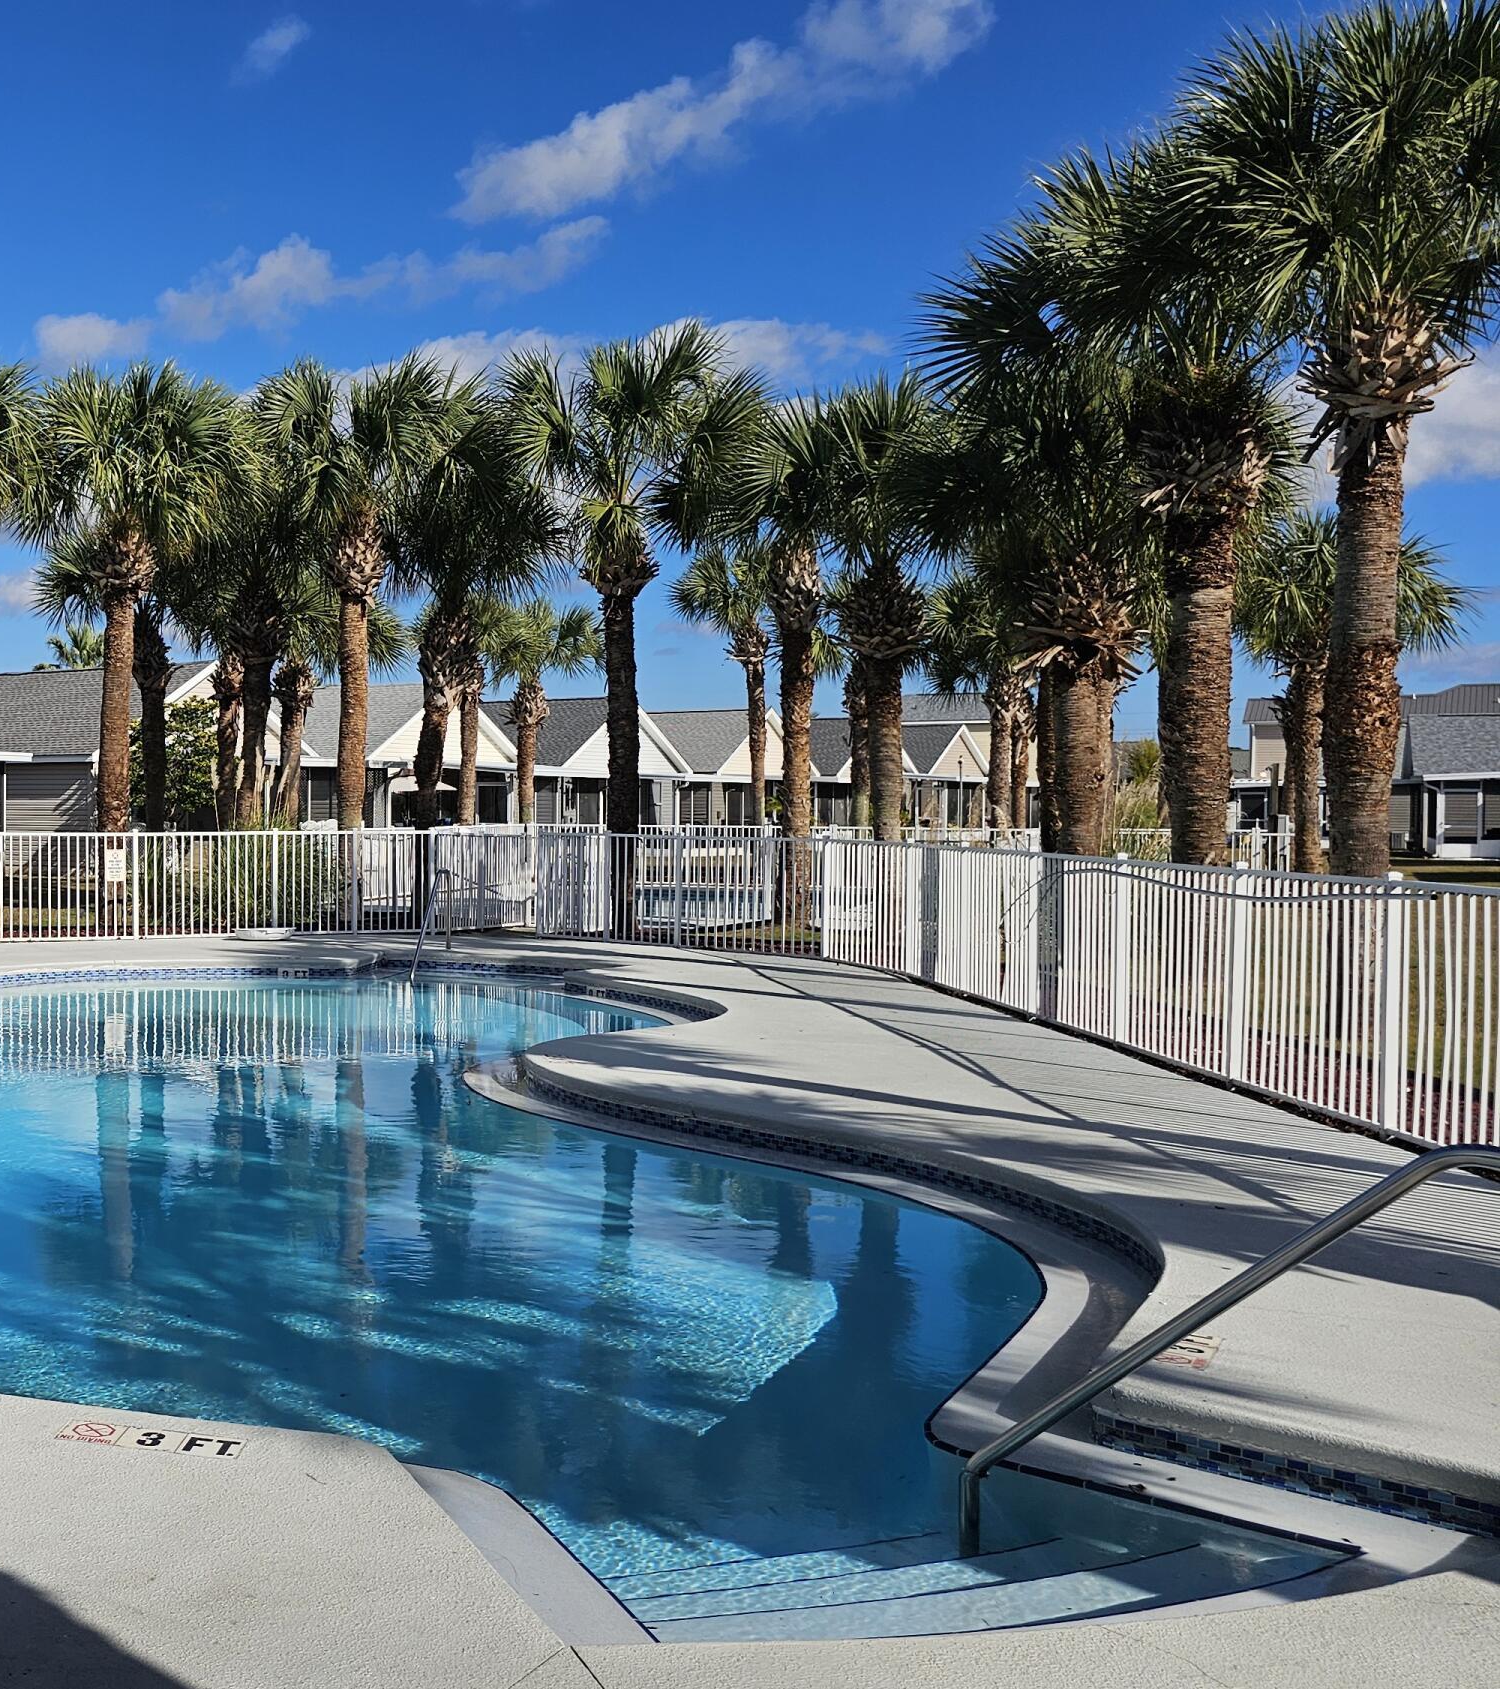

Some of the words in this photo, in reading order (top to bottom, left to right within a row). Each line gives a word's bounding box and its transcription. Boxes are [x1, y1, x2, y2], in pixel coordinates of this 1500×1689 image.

[76, 1435, 112, 1446] DIVING
[135, 1432, 166, 1447] 3
[182, 1436, 242, 1457] FT.
